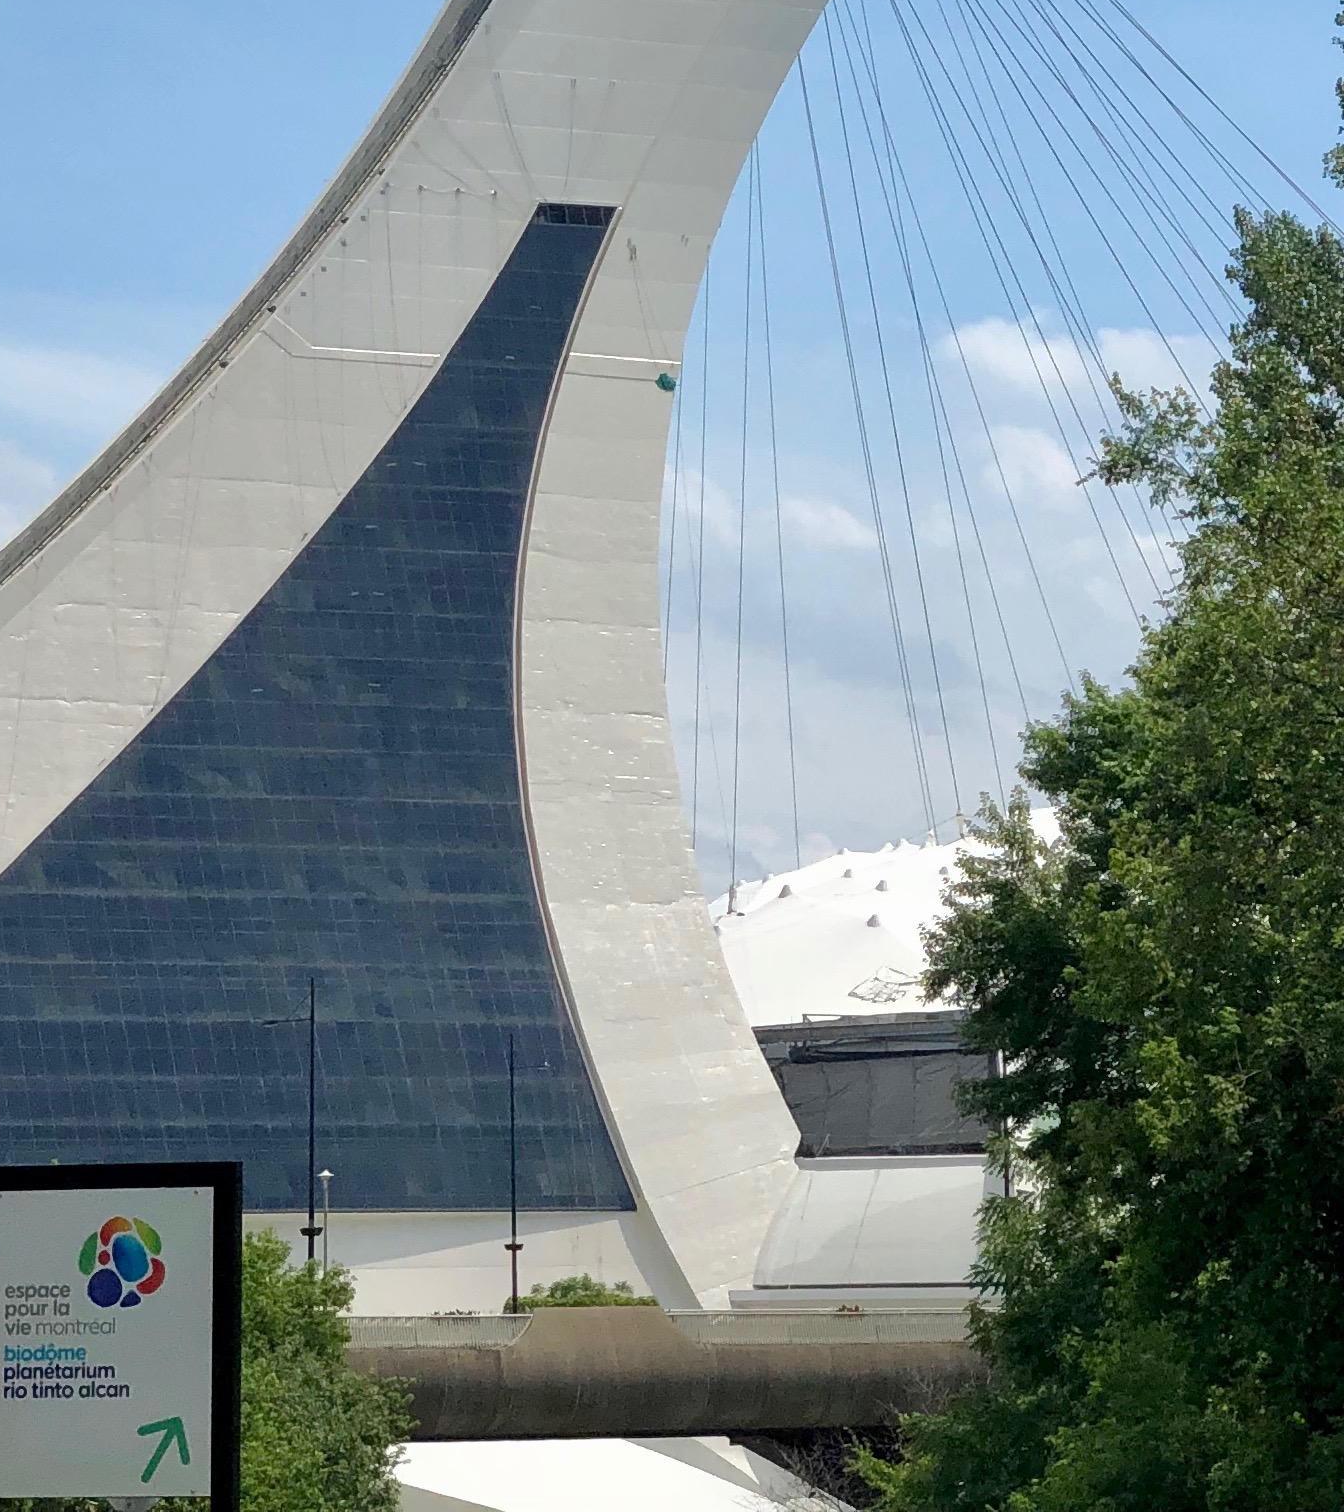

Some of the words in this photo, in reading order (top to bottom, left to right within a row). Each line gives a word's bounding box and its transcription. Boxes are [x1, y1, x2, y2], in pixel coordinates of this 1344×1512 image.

[5, 1284, 71, 1302] espace
[4, 1303, 49, 1320] pour
[53, 1299, 70, 1316] la
[4, 1319, 32, 1336] vie
[35, 1316, 116, 1336] montréal
[3, 1343, 87, 1362] biodôme
[3, 1361, 116, 1383] planétarium
[3, 1381, 28, 1399] rio
[32, 1381, 75, 1399] tinto
[78, 1380, 131, 1399] alcan
